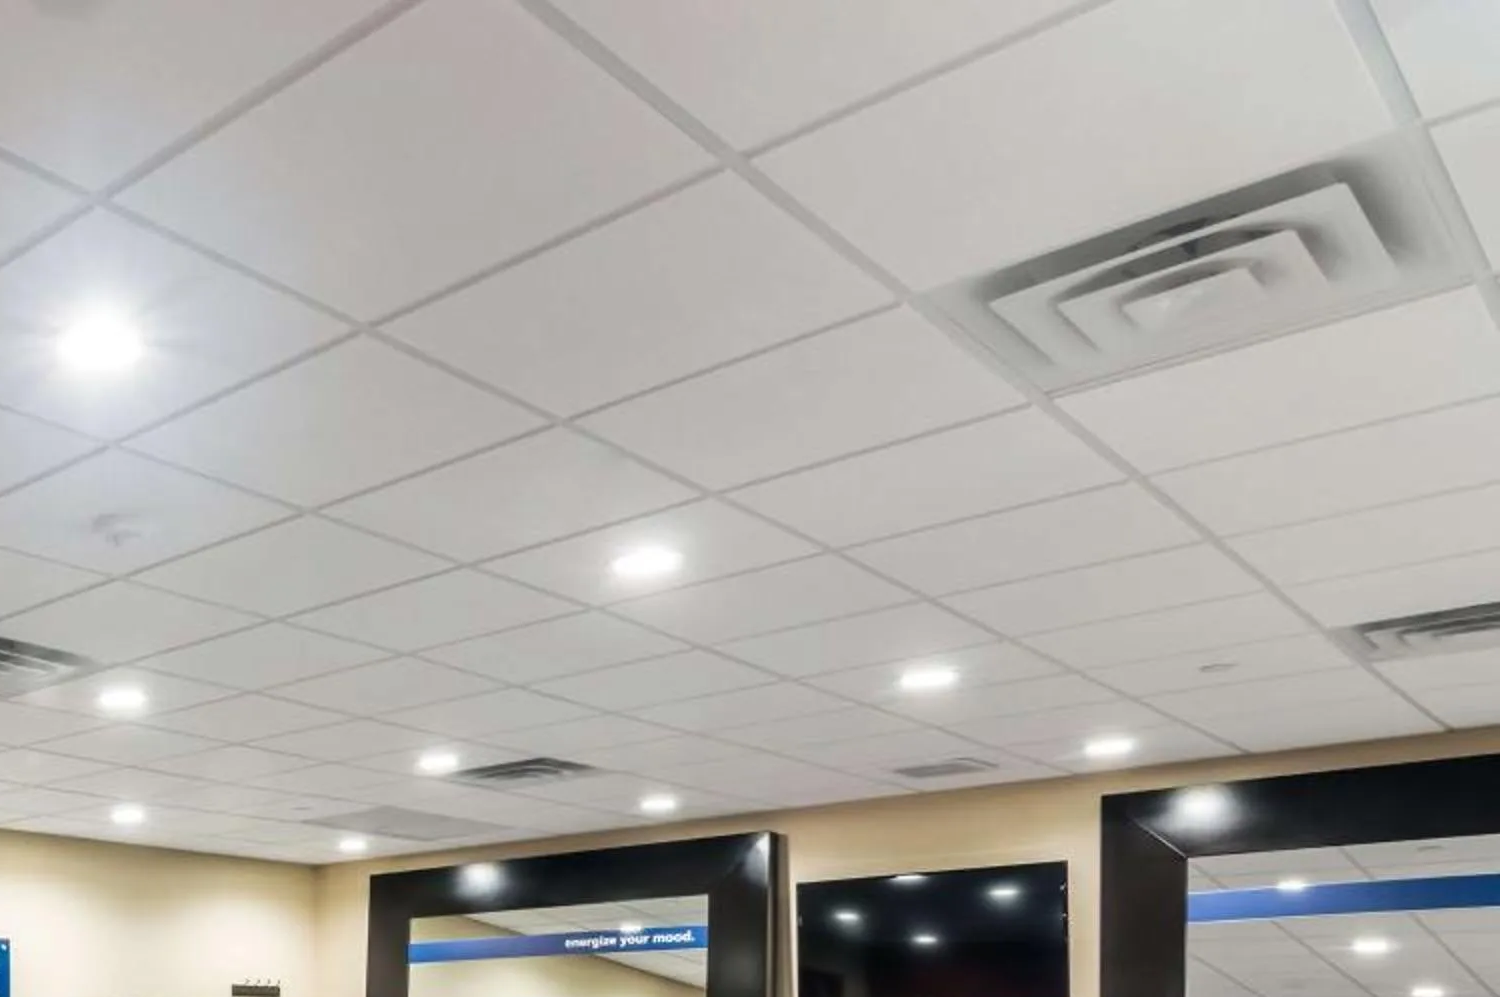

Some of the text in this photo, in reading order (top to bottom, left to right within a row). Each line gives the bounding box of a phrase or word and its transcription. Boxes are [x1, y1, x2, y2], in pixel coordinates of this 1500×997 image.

[564, 930, 695, 949] energize your mood.
